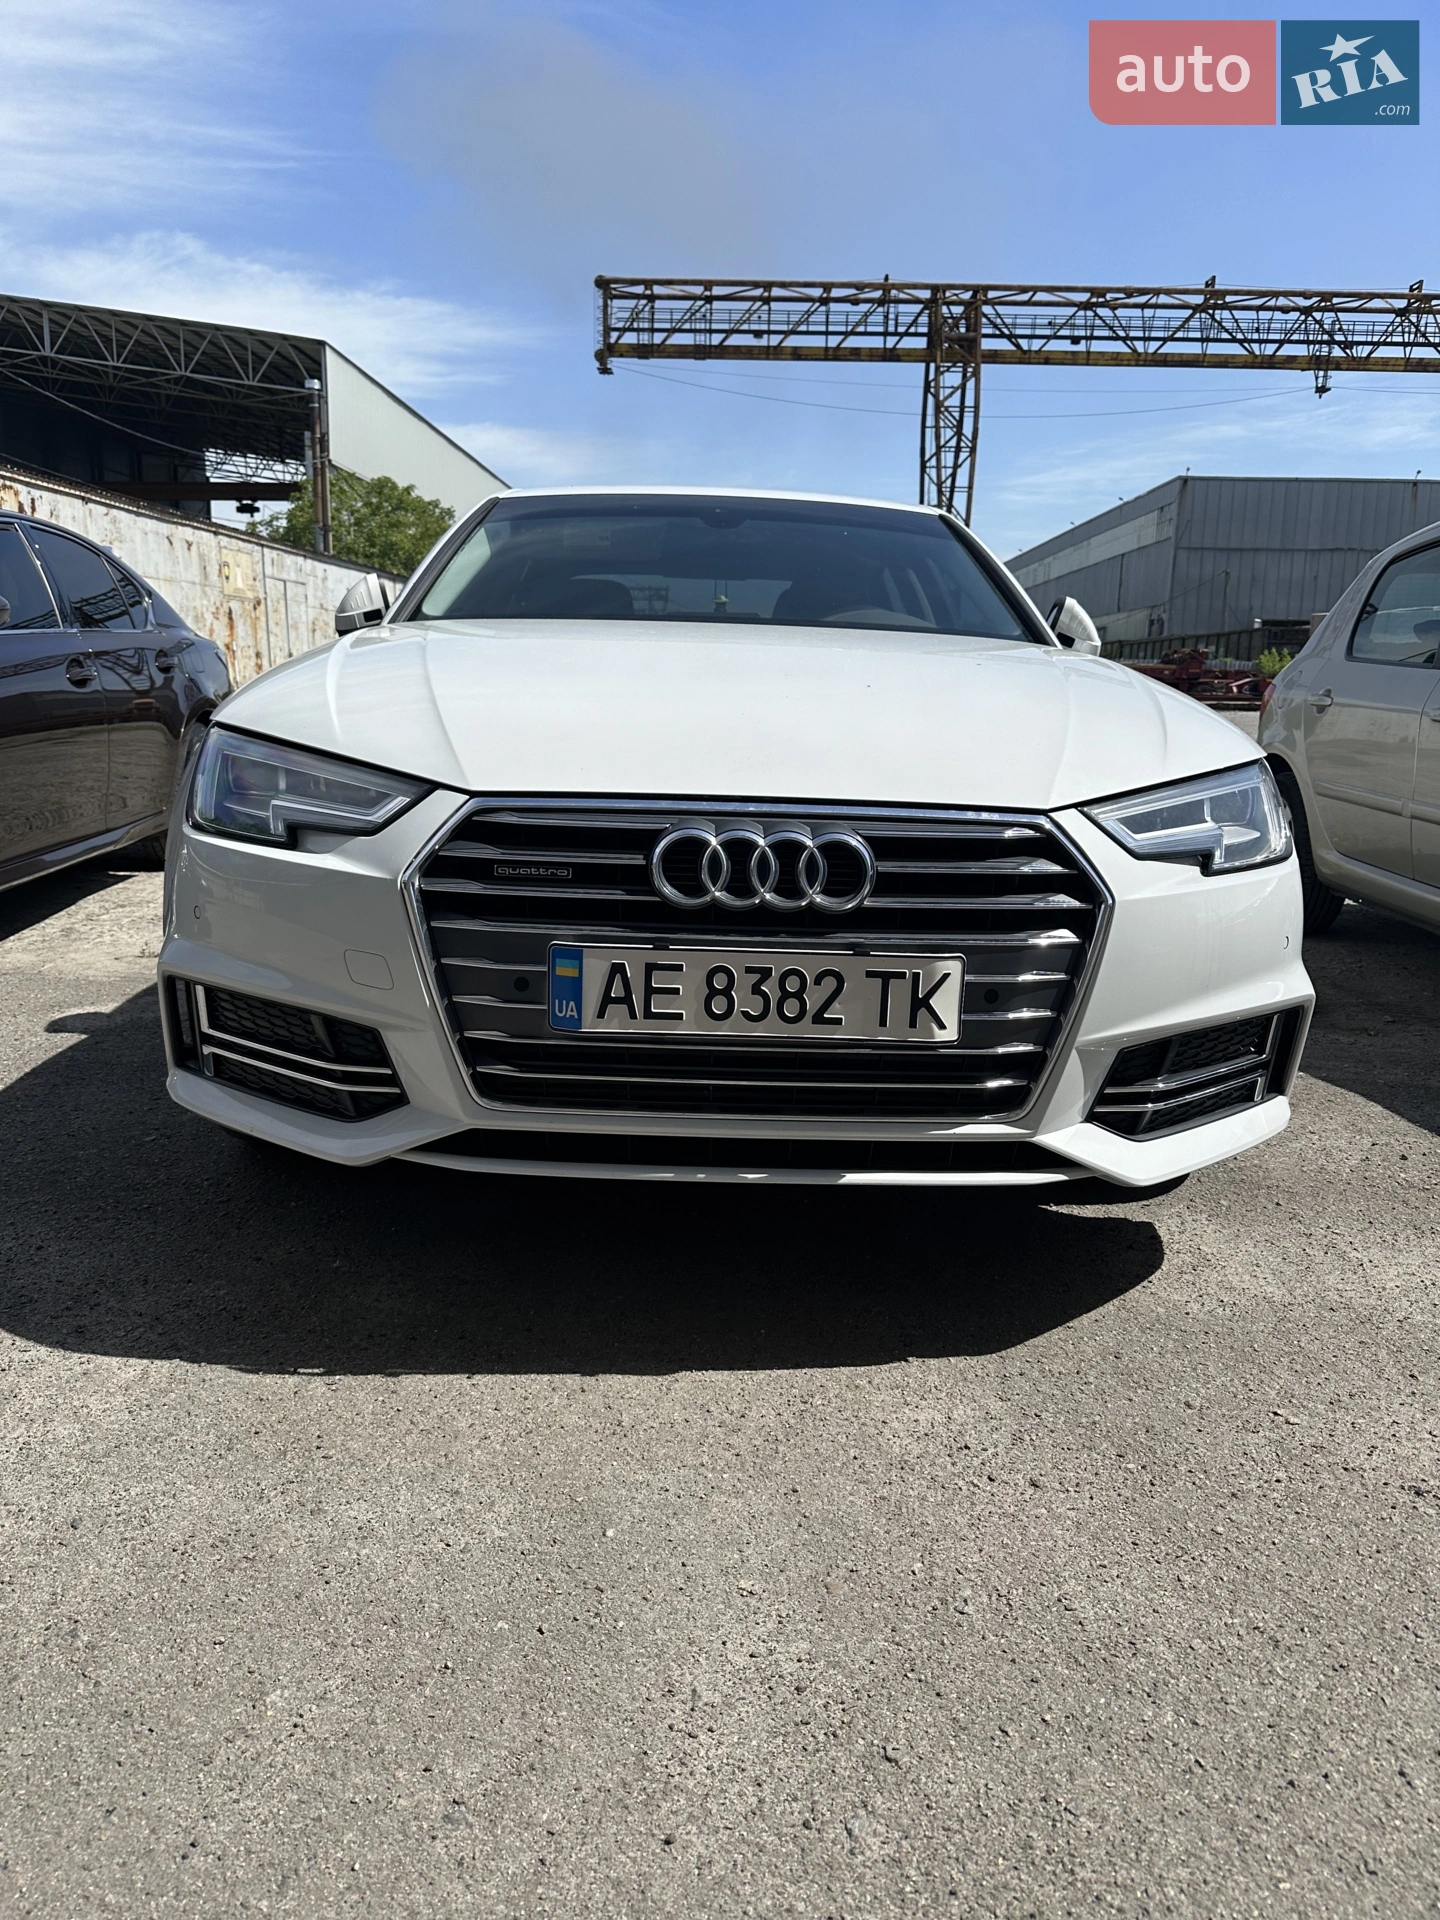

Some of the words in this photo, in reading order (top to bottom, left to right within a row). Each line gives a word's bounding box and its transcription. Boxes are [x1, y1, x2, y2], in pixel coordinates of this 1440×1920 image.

[498, 867, 568, 876] quattro
[596, 961, 686, 1021] AE
[703, 963, 846, 1026] 8382
[864, 969, 952, 1031] TK
[554, 998, 579, 1019] UA
